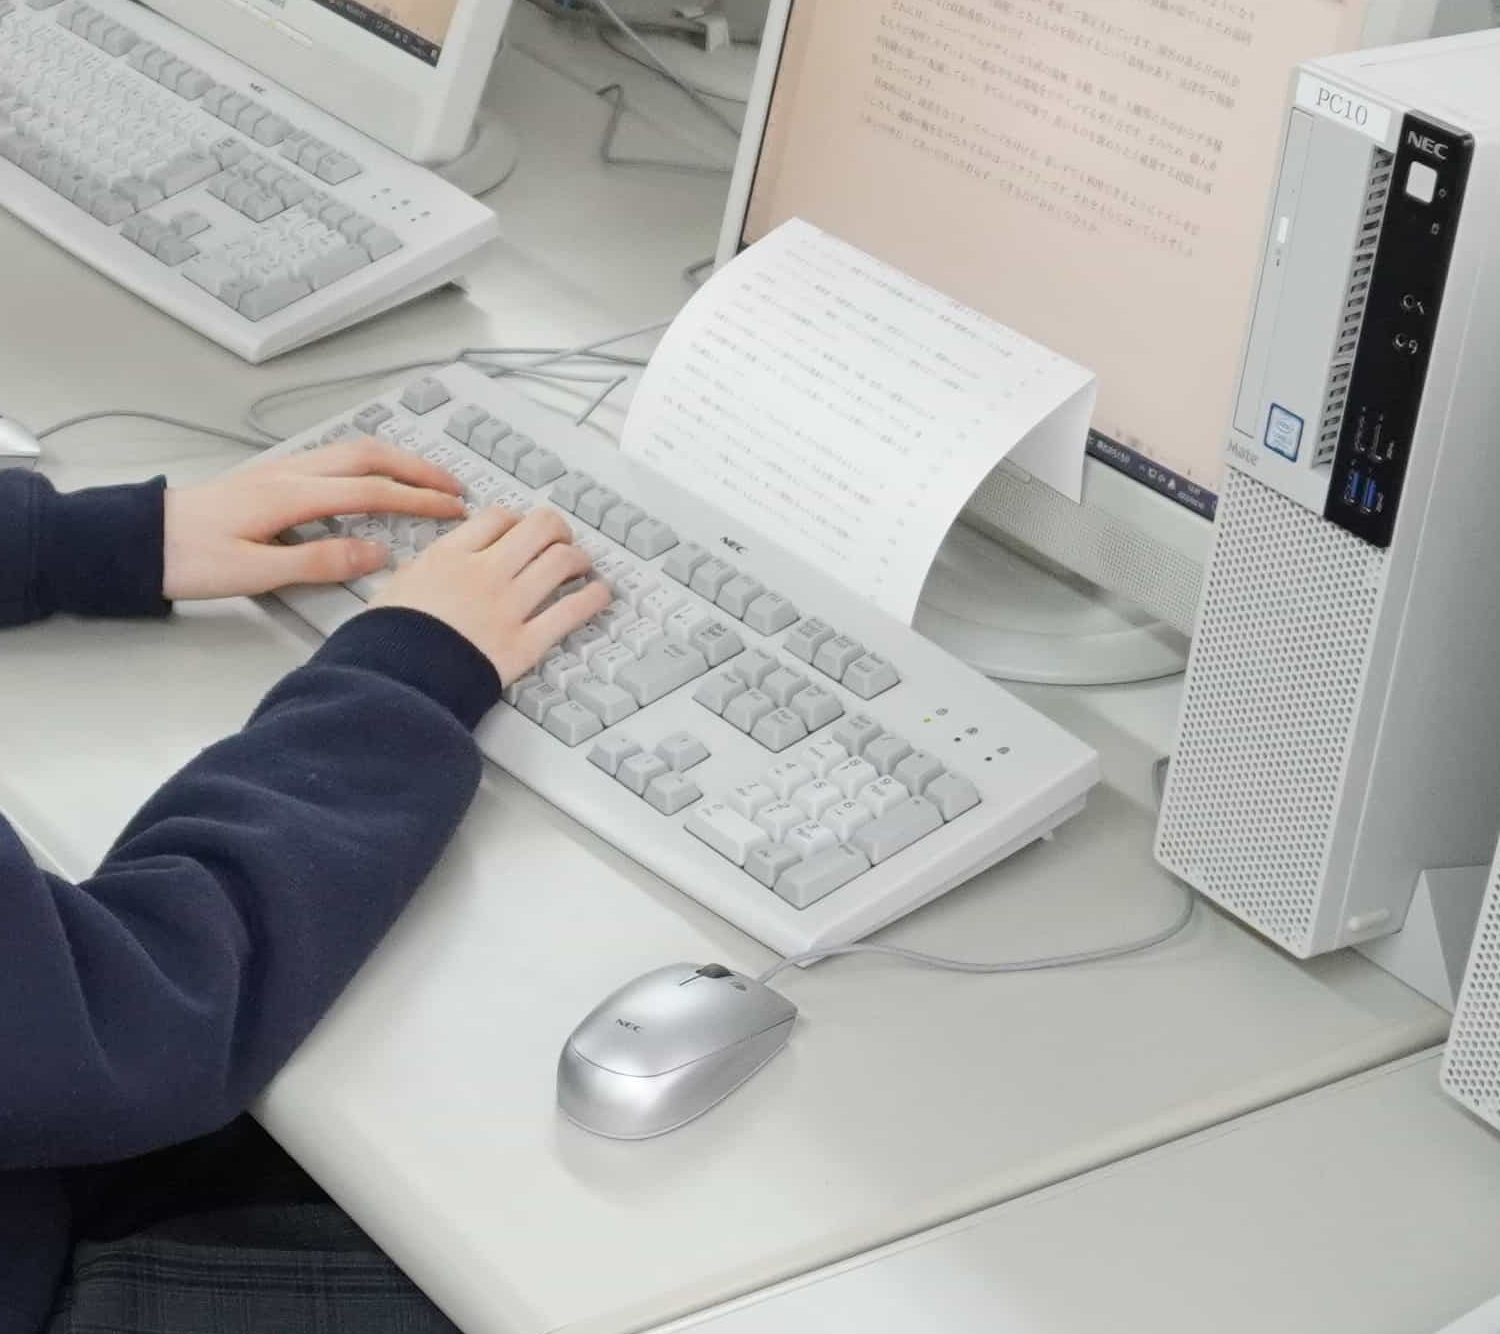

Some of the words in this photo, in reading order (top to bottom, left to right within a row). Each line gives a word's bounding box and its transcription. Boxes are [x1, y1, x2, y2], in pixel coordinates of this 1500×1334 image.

[1315, 86, 1369, 127] PC10
[1407, 130, 1450, 161] NEC
[1227, 439, 1259, 468] Mate
[719, 535, 749, 555] NEC
[615, 1017, 644, 1033] NEC
